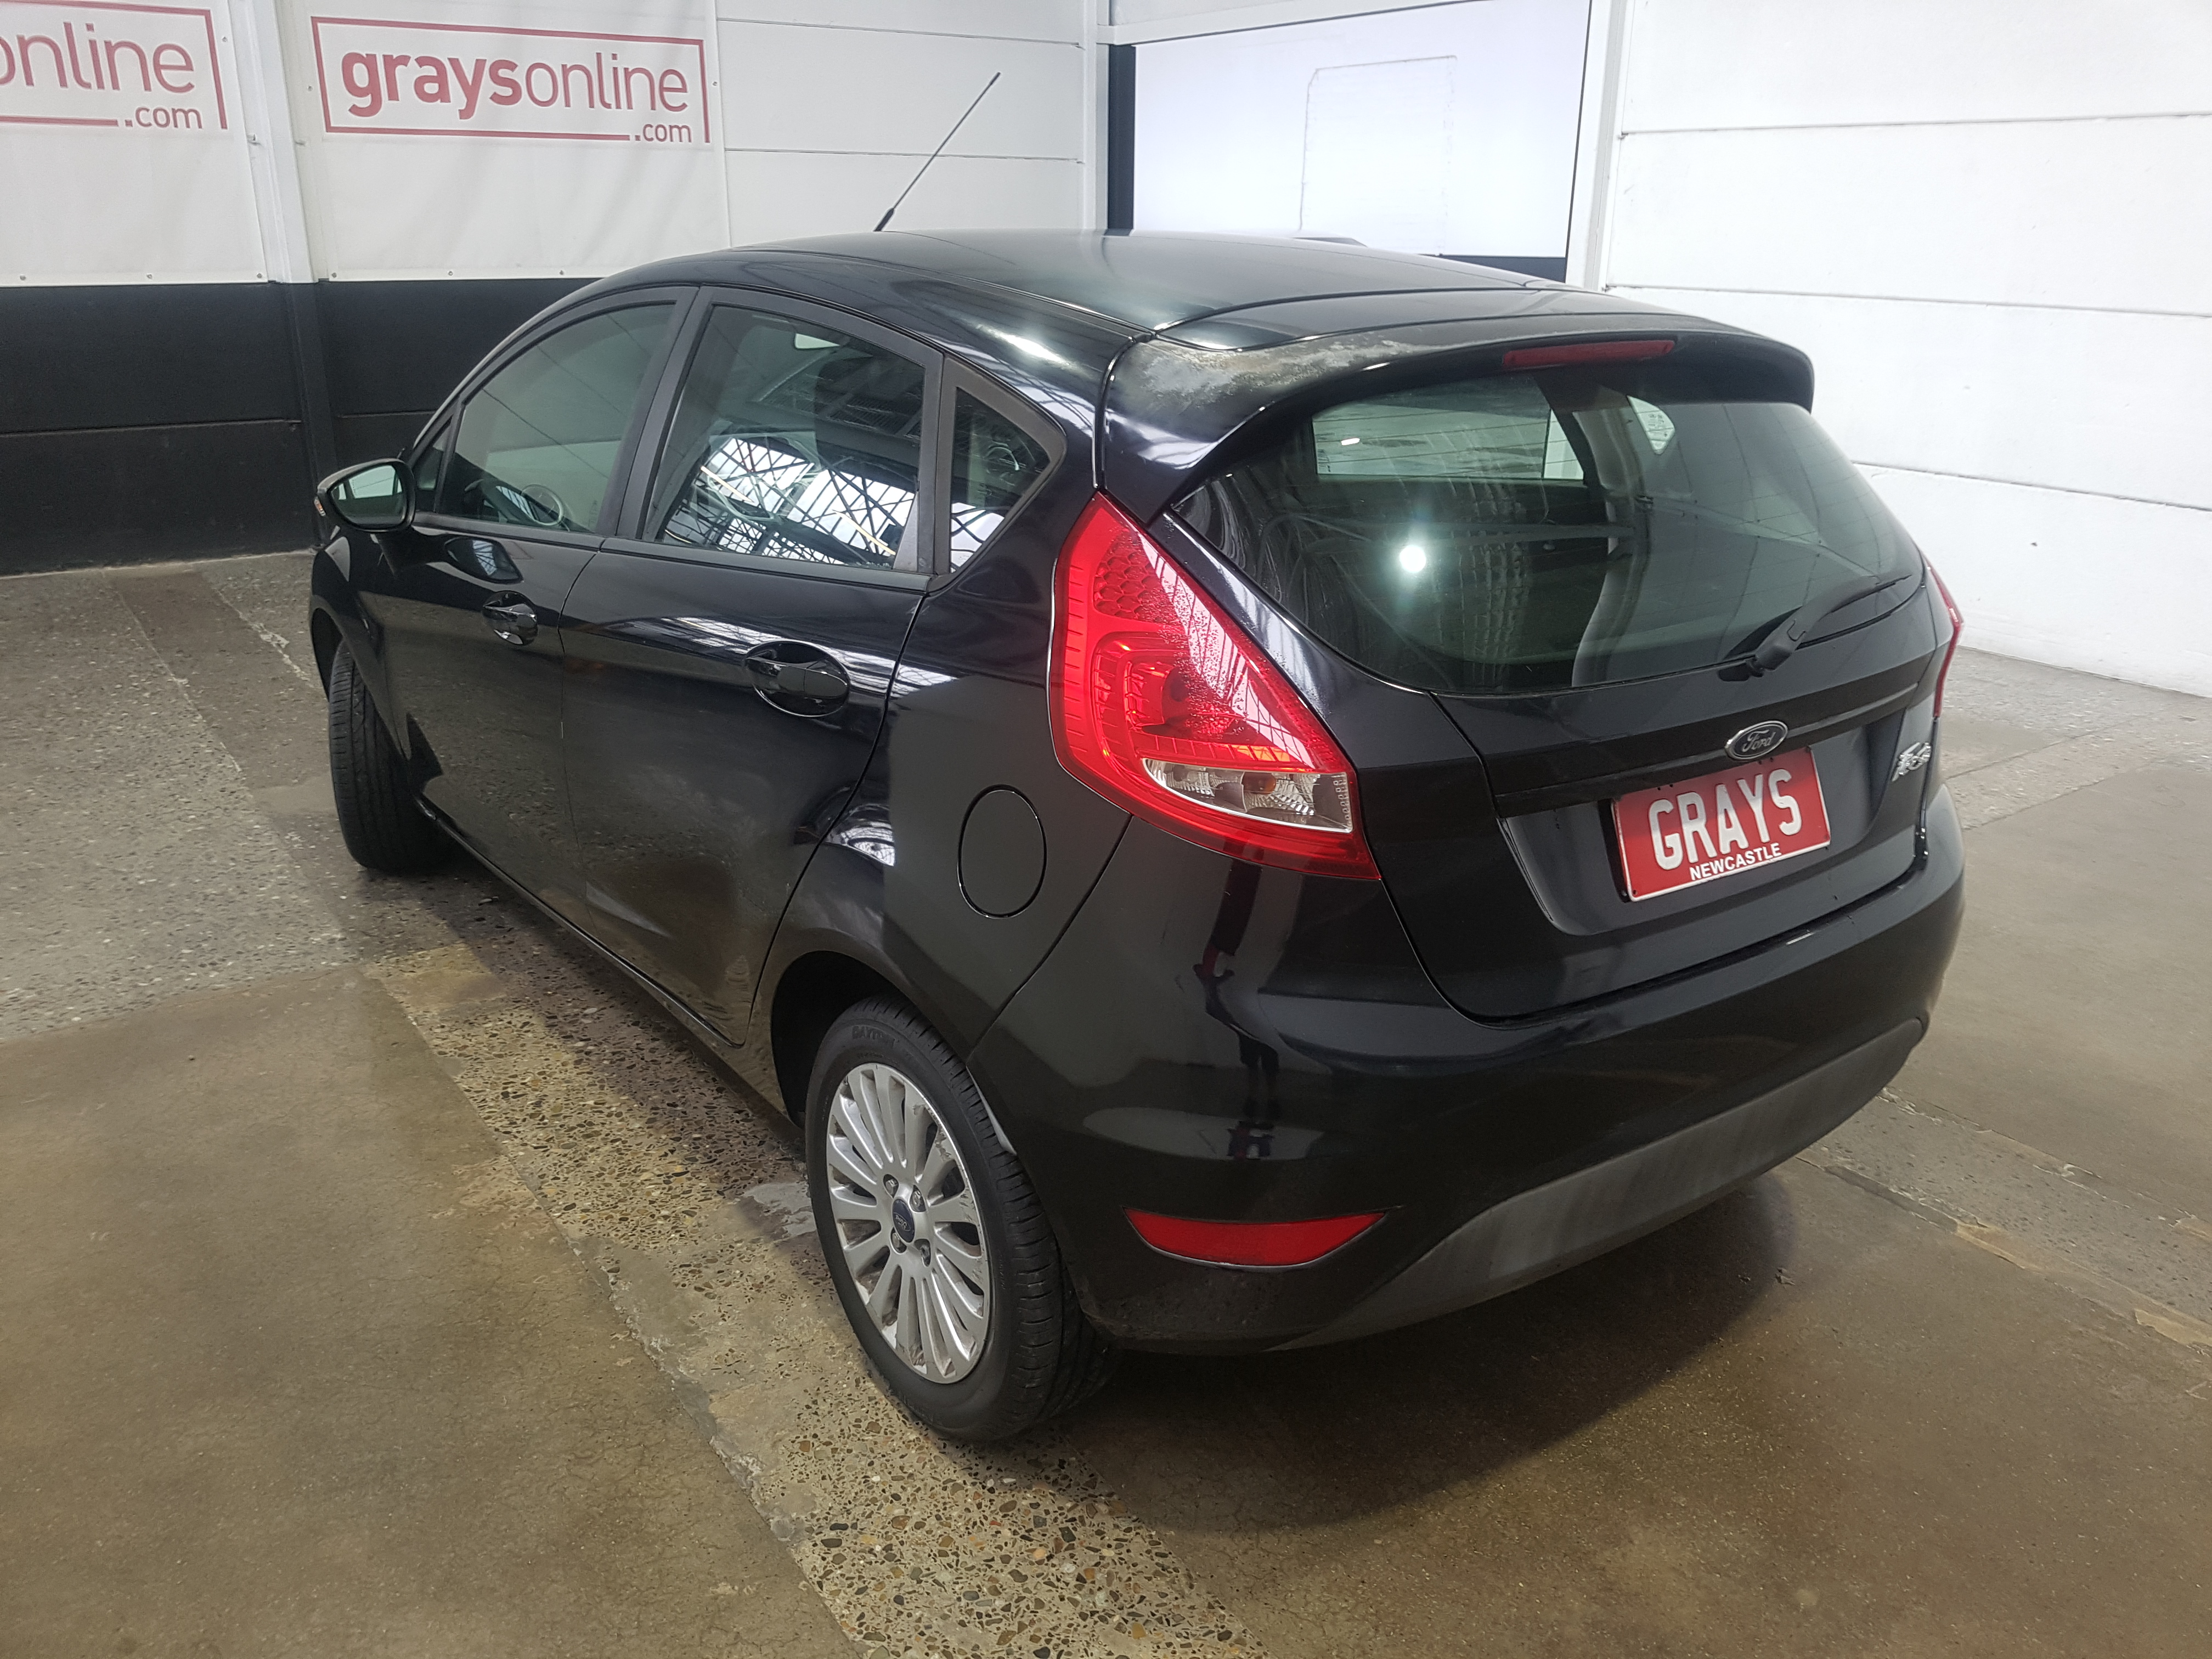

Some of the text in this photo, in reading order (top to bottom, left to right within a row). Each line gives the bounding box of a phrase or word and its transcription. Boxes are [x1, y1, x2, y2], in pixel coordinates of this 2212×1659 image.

[341, 52, 689, 120] graysonline
[125, 106, 202, 129] .com
[635, 123, 692, 143] .com
[1742, 729, 1776, 752] Ford
[1648, 769, 1802, 871] GRAYS
[1690, 843, 1782, 881] NEWCASTLE
